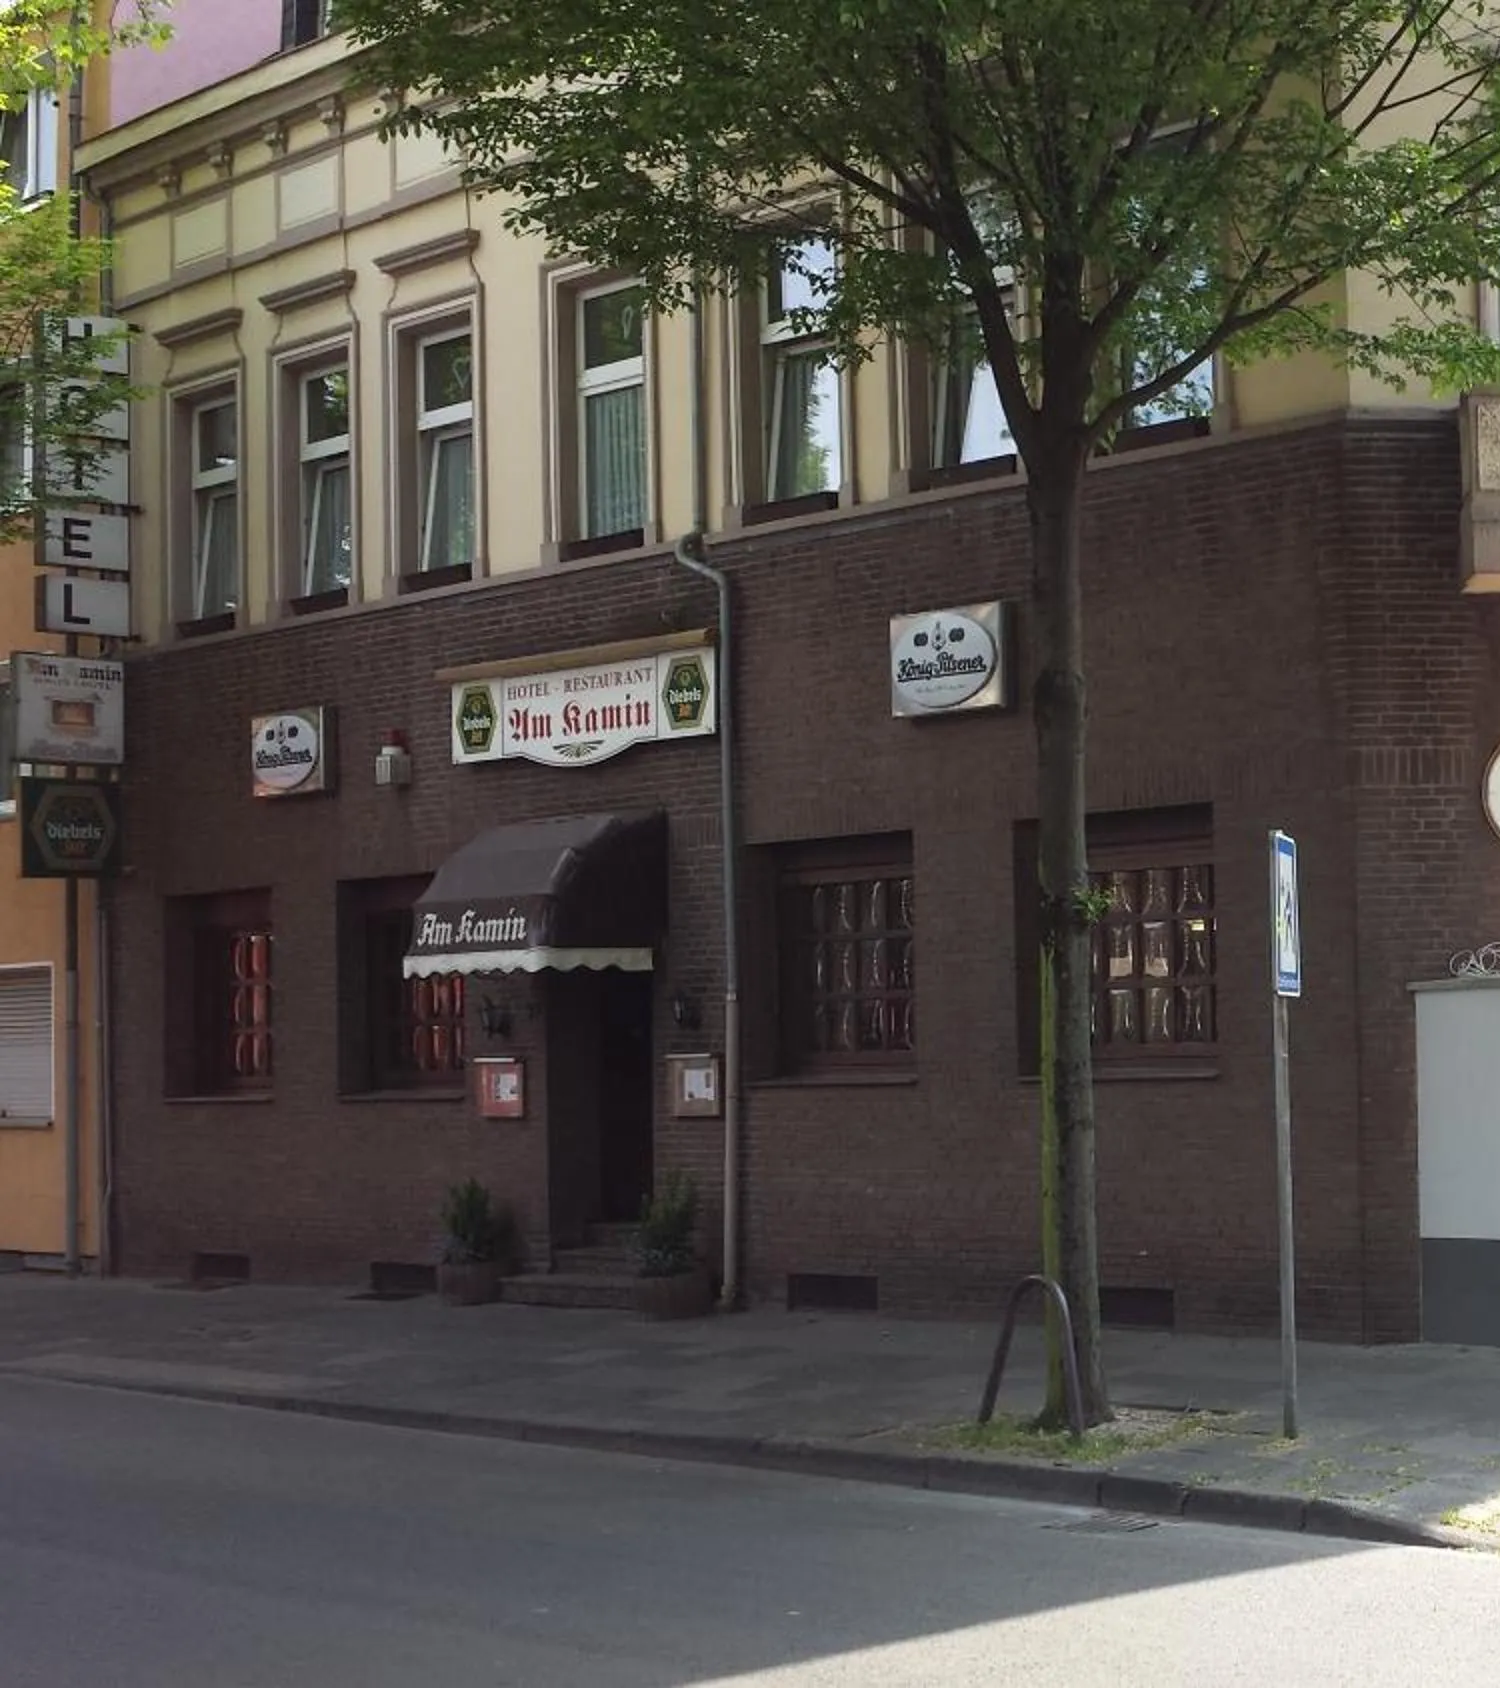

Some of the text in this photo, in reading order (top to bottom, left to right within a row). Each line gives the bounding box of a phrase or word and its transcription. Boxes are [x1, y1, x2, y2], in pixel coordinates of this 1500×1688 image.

[507, 683, 550, 700] HOTEL
[563, 667, 653, 693] RESTAURANT
[509, 694, 650, 742] Am Kamin
[417, 907, 526, 946] Am Kamin
